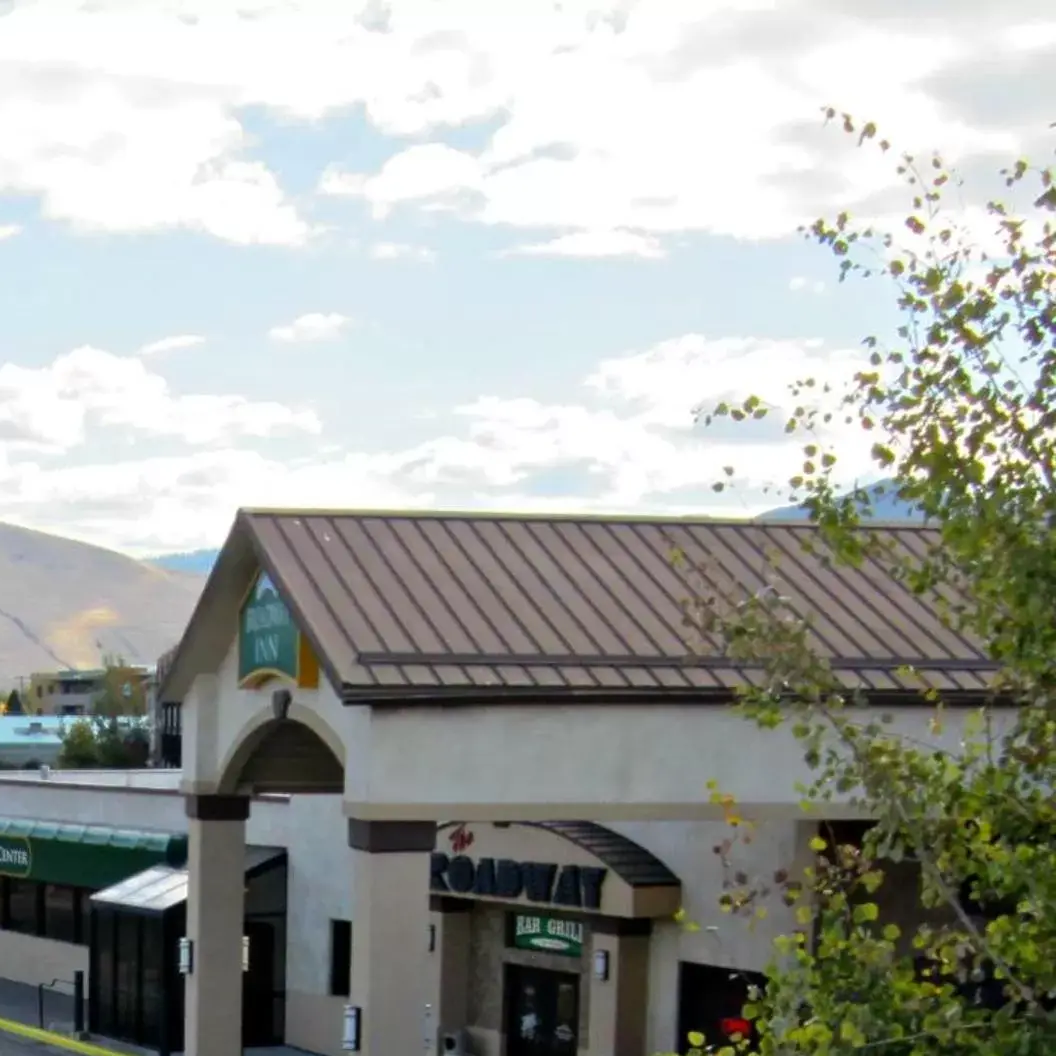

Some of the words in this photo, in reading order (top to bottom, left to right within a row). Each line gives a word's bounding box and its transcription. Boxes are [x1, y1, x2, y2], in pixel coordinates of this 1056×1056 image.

[254, 633, 279, 664] INN
[430, 852, 608, 910] ROADWAY
[516, 915, 541, 936] BAR
